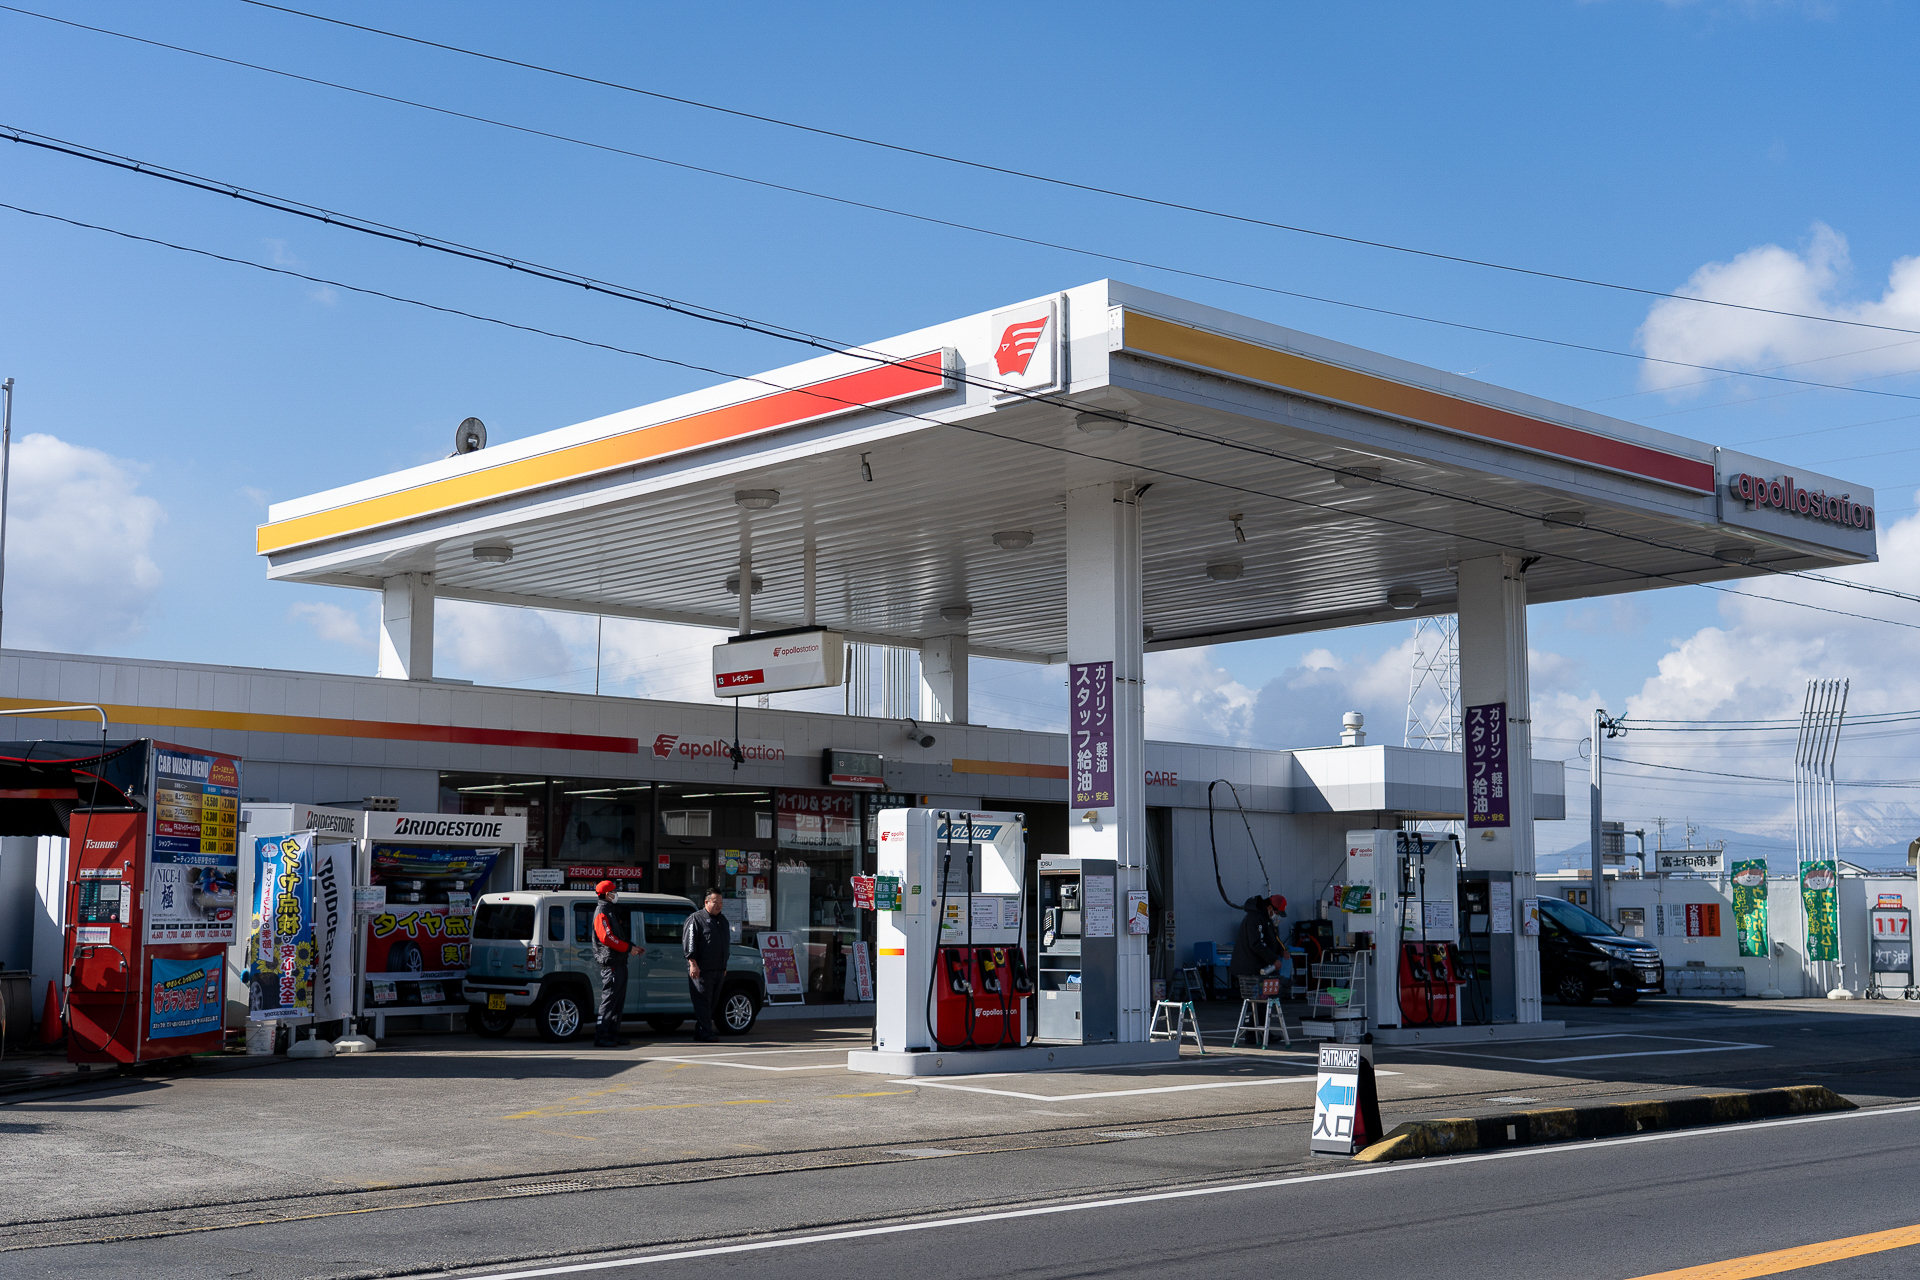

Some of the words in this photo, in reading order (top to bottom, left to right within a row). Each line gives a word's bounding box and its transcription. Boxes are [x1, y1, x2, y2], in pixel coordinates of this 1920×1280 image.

[1735, 473, 1875, 530] apollostation
[782, 644, 819, 656] apollostation
[717, 677, 725, 685] 13
[732, 674, 753, 683] レギュラー
[1095, 664, 1108, 773] ガソリン・軽油
[1076, 666, 1092, 792] スタッフ給油
[1470, 708, 1488, 813] スタッフ給油
[1489, 707, 1503, 798] ガソリン・軽油
[157, 754, 171, 773] CAR
[172, 756, 191, 776] WASH
[191, 759, 209, 779] MENU
[1144, 769, 1178, 787] CARE
[777, 793, 854, 812] オイル&タイヤ
[1077, 791, 1109, 802] 安心・安全
[306, 810, 355, 833] BRIDGESTONE
[795, 812, 834, 829] ショップ
[1473, 812, 1505, 822] 安心・安全
[394, 817, 503, 838] BRIDGESTONE
[941, 825, 992, 838] AdBlue
[790, 833, 842, 847] BRIDGESTONE
[1660, 855, 1718, 868] 富士和商事
[570, 867, 603, 876] ZERIOUS
[608, 868, 642, 877] ZERIOUS
[741, 877, 748, 888] R
[160, 883, 174, 910] 極
[373, 911, 473, 938] タイヤ点
[1689, 904, 1700, 936] 火気厳禁
[1875, 917, 1908, 934] 117
[1875, 949, 1909, 965] 灯油
[855, 943, 870, 997] 従業員通路
[1321, 1049, 1357, 1067] ENTRANCE
[1313, 1113, 1354, 1138] 入口
